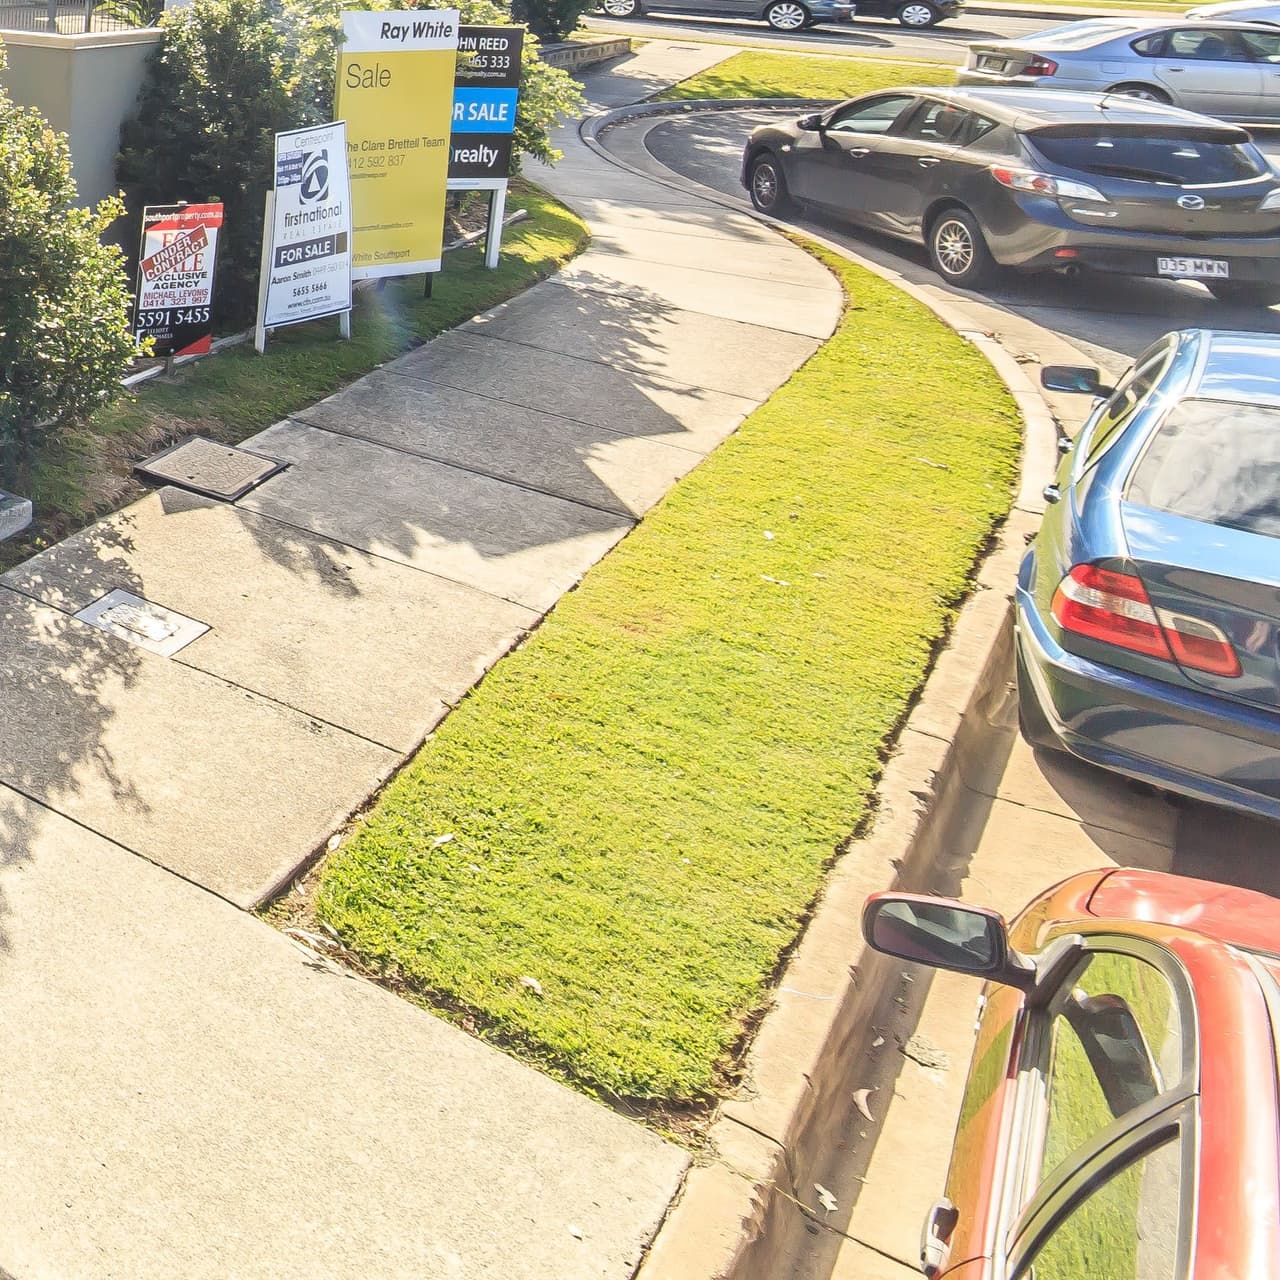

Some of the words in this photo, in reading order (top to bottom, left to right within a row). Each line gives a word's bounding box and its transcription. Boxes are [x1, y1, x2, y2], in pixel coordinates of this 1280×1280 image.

[380, 22, 409, 42] Ray
[412, 22, 452, 39] White
[457, 37, 477, 50] HN
[479, 37, 509, 50] REED
[490, 56, 510, 68] 333
[346, 63, 391, 89] Sale
[468, 103, 509, 121] SALE
[361, 140, 385, 152] Clare
[388, 138, 419, 150] Brettell
[422, 137, 445, 148] Team
[367, 156, 385, 168] 592
[454, 144, 499, 167] realty
[153, 237, 192, 264] UNDER
[280, 248, 302, 264] FOR
[305, 241, 331, 258] SALE
[374, 249, 410, 261] Southport
[145, 238, 206, 280] CONTRACT
[153, 280, 200, 290] AGENCY
[271, 275, 291, 285] Aaron
[292, 270, 312, 280] Smith
[144, 291, 177, 300] MICHAEL
[292, 286, 309, 297] 5655
[311, 282, 328, 293] 5666
[143, 300, 165, 308] 0414
[171, 298, 186, 306] 323
[137, 311, 171, 327] 5591
[175, 308, 210, 324] 5455
